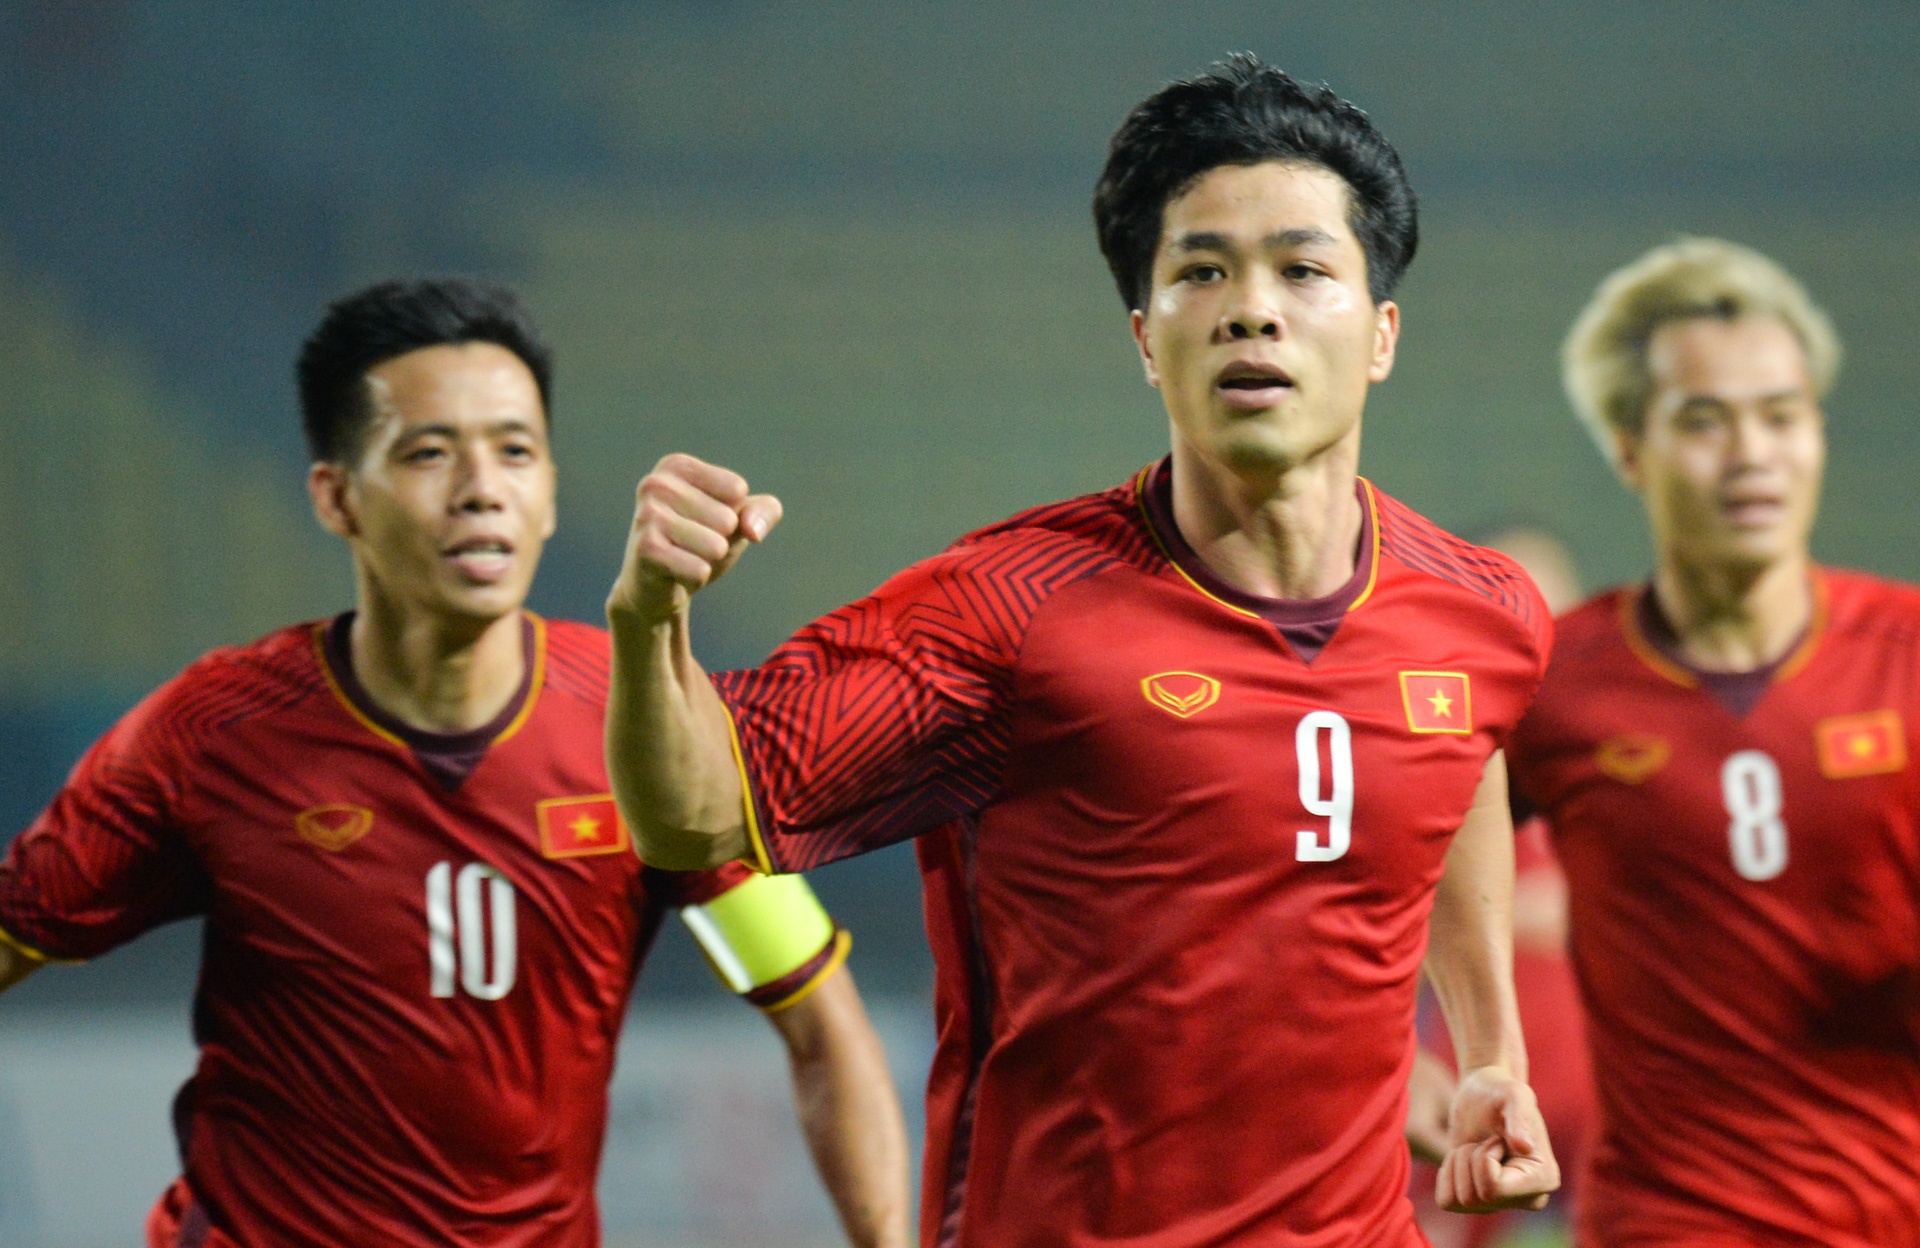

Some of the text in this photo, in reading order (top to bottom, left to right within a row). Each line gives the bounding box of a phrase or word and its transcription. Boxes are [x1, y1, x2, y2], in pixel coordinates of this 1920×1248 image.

[1295, 709, 1355, 863] 9
[1720, 749, 1788, 881] 8
[425, 861, 517, 1000] 10
